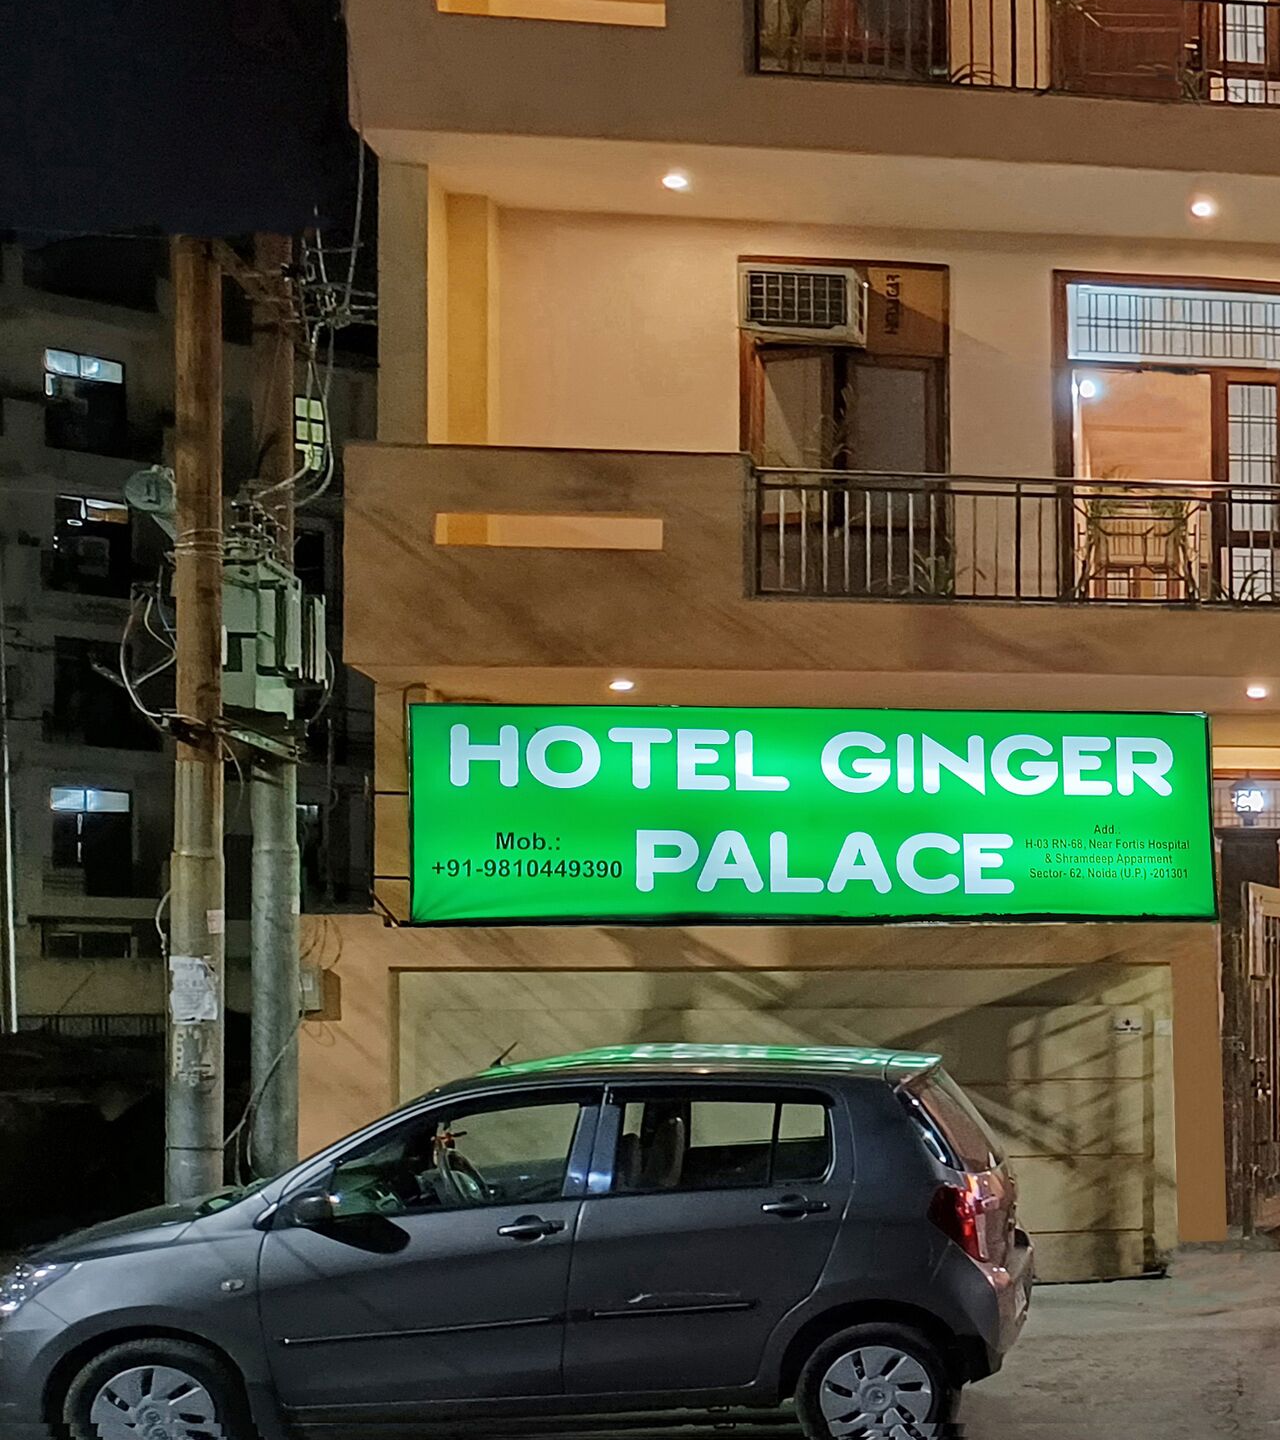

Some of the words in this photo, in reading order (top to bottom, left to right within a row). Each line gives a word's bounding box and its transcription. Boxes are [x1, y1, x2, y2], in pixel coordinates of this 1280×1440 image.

[449, 723, 791, 791] HOTEL
[820, 731, 1175, 796] GINGER
[495, 832, 560, 851] Mob.:
[1025, 839, 1049, 849] H-03
[1088, 839, 1113, 849] Near
[1115, 839, 1145, 849] Fortis
[1148, 839, 1190, 852] Hospital
[431, 858, 623, 878] +91-9810449390
[635, 829, 1015, 894] PALACE
[1044, 854, 1052, 864] &
[1055, 853, 1114, 866] Shramdeep
[1116, 854, 1173, 866] Apparment
[1087, 868, 1118, 879] Noida
